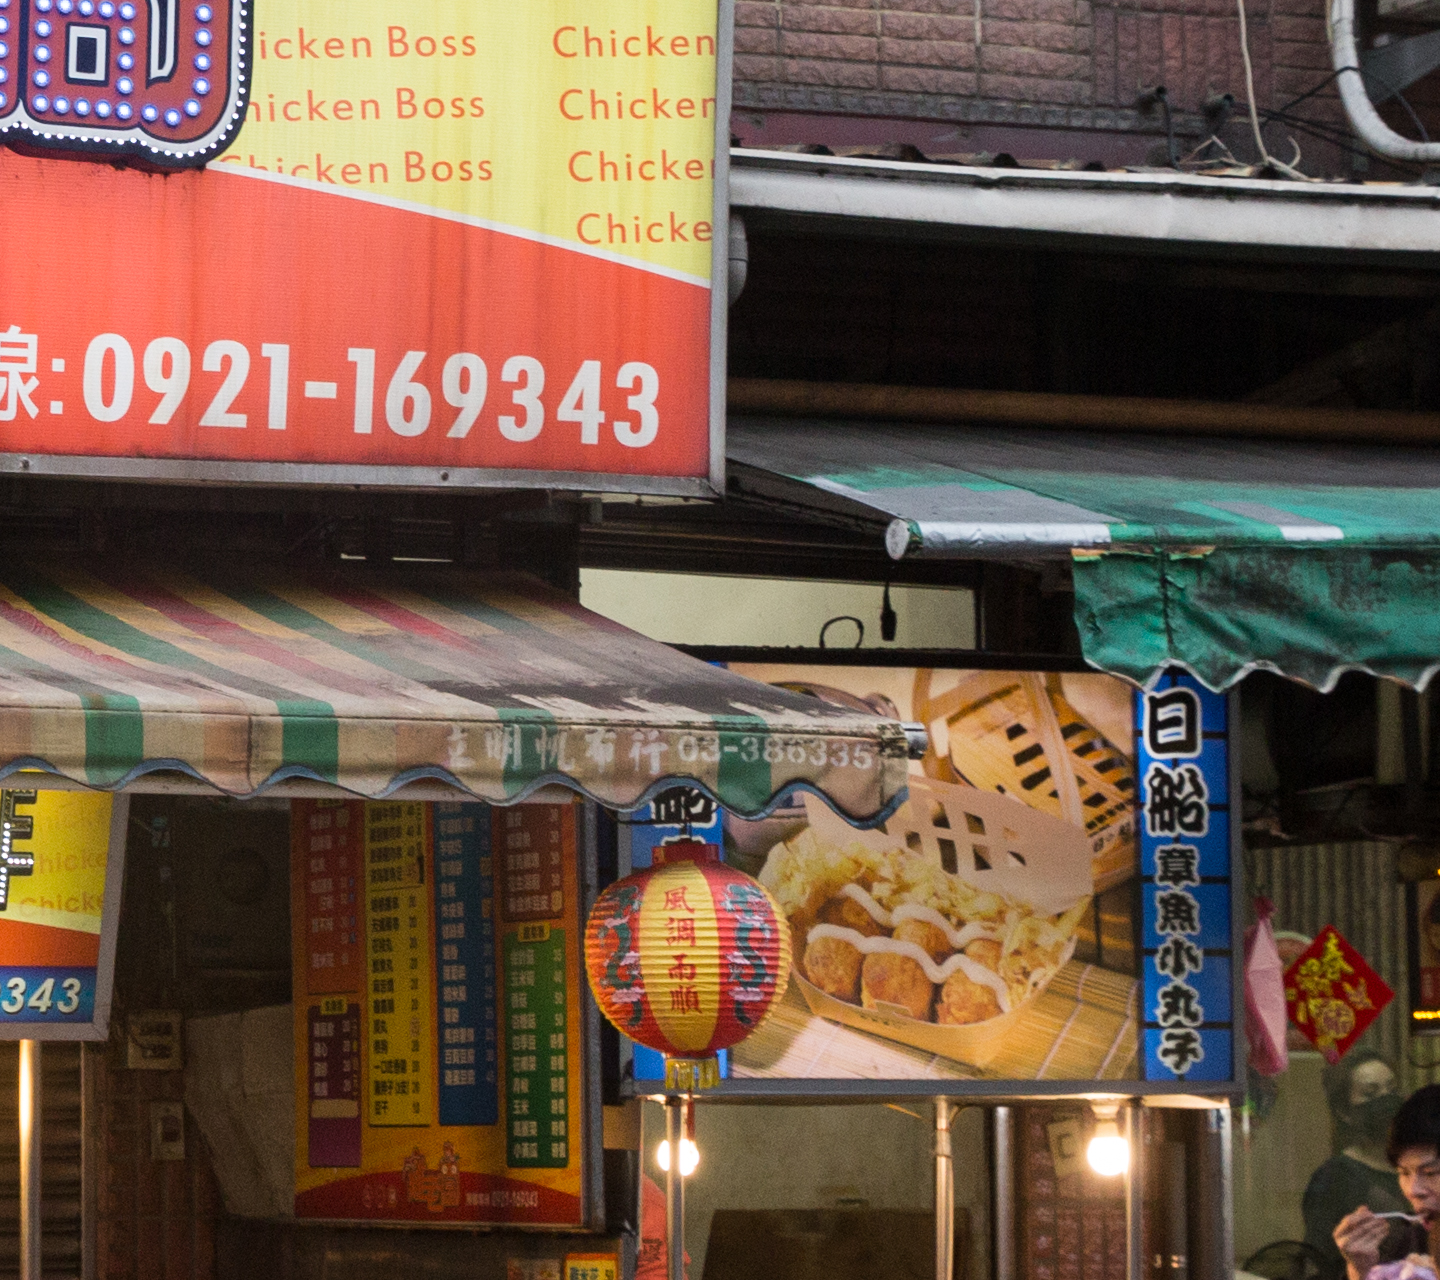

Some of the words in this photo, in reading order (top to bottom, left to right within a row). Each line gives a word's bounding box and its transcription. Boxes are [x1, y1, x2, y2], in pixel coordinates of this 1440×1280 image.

[388, 26, 476, 57] Boss
[553, 26, 714, 58] Chicken
[396, 88, 484, 119] Boss
[405, 151, 492, 182] Boss
[568, 150, 713, 182] Chicke
[662, 885, 702, 1016] 風調雨順
[1153, 843, 1204, 1076] 章魚小丸子
